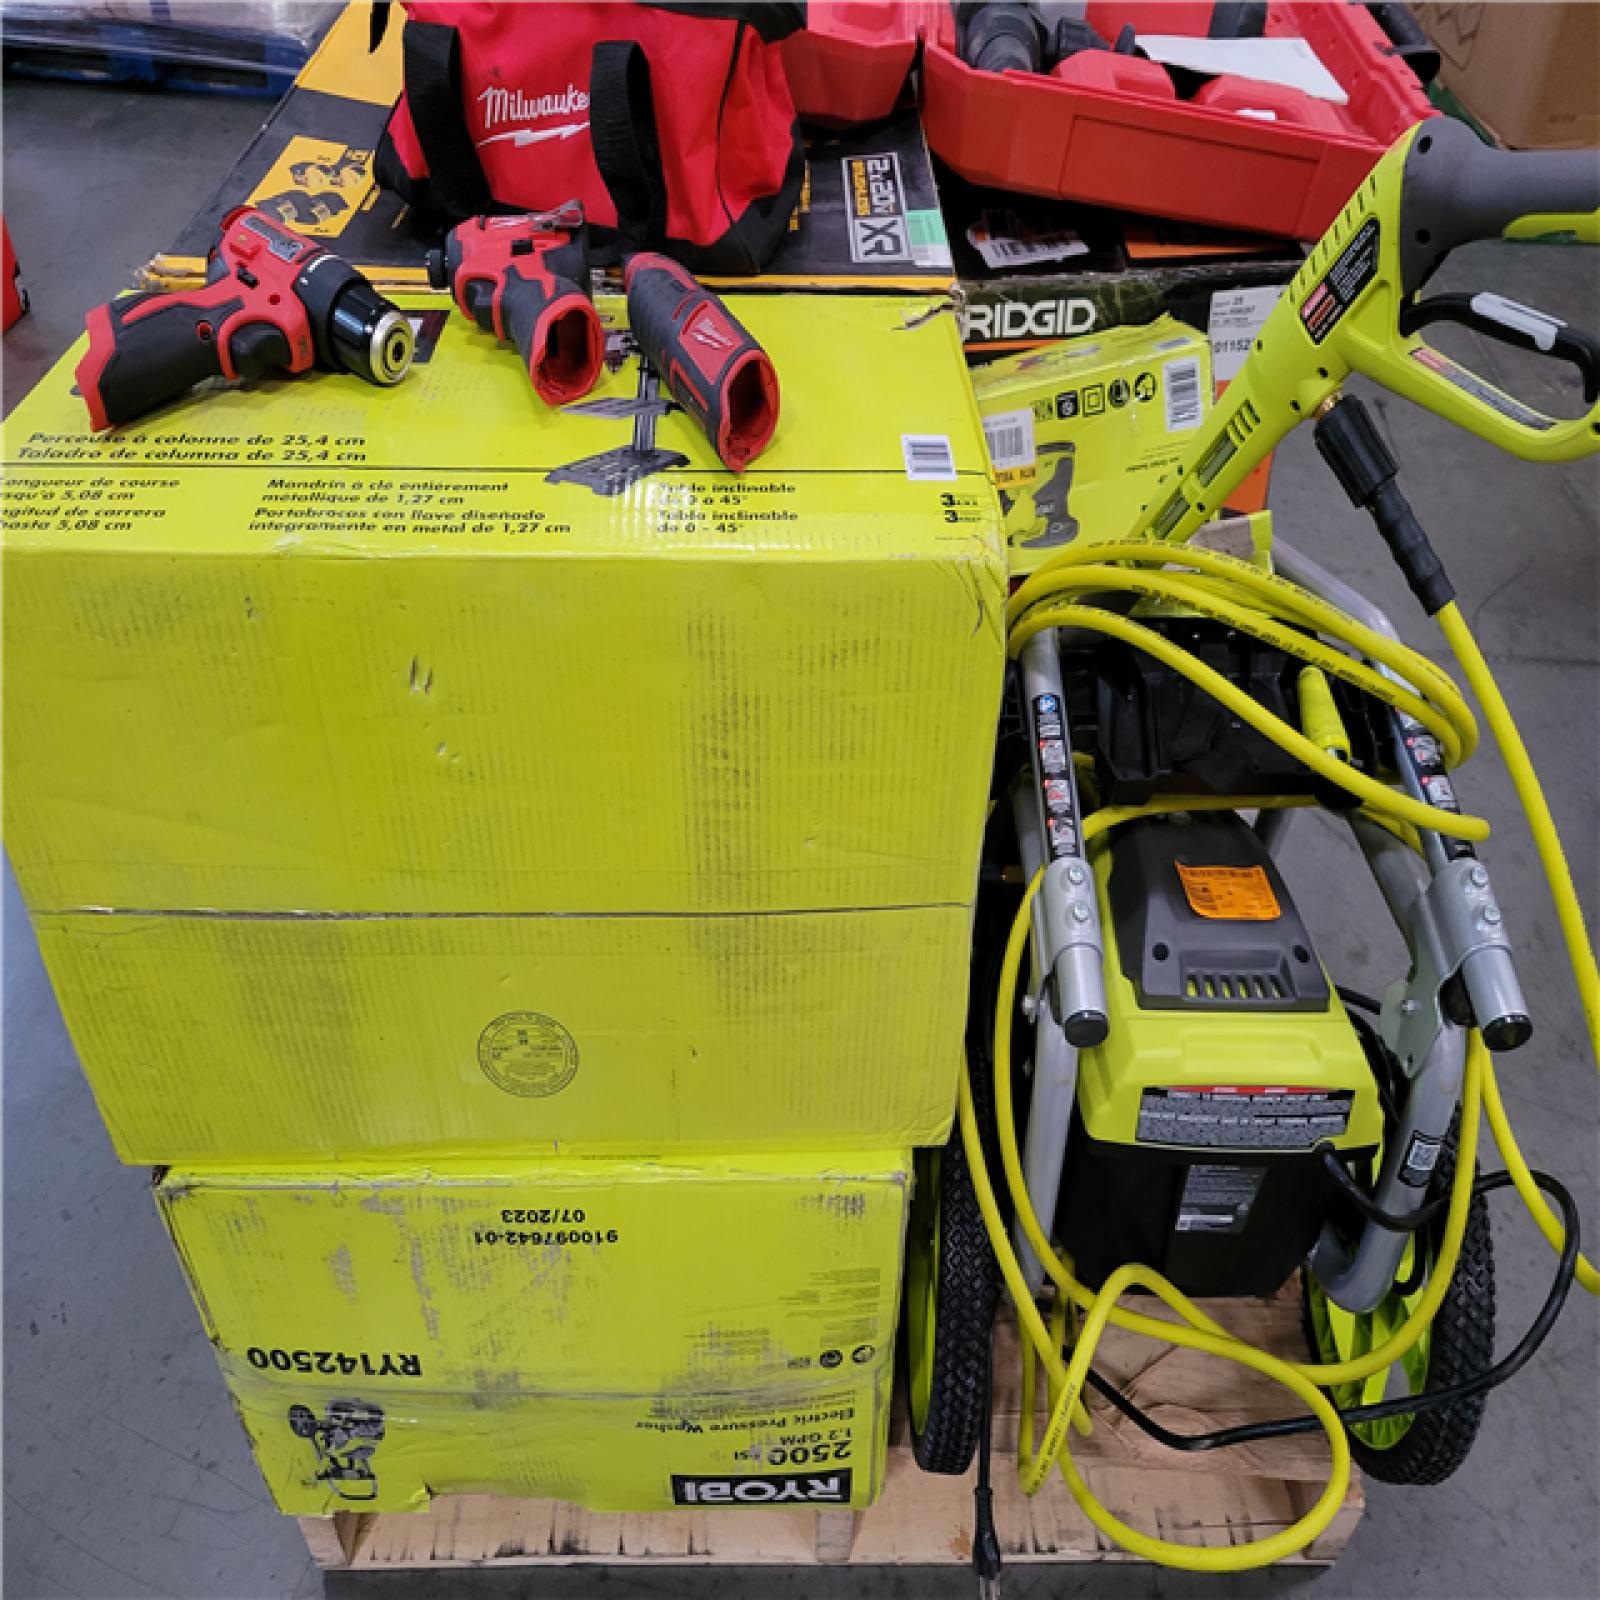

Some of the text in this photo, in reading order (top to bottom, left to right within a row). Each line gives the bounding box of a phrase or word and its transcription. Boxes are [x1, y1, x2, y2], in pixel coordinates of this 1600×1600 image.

[477, 83, 590, 128] Milwauke
[859, 220, 903, 258] XR
[964, 298, 1097, 339] RIDGID
[28, 432, 125, 444] Perceuse
[154, 432, 240, 445] colonne
[247, 434, 274, 446] de
[281, 434, 329, 448] 25,4
[335, 437, 366, 446] cm
[18, 447, 366, 463] Taladro de columna de 25,4 cm
[3, 477, 181, 488] ongueur de course
[267, 479, 345, 489] Mandrin
[712, 482, 796, 494] inclinable
[60, 489, 103, 501] 5,08
[107, 491, 135, 501] cm
[366, 492, 388, 503] de
[397, 494, 433, 505] 1,27
[439, 496, 464, 505] cm
[940, 493, 956, 506] 3
[65, 504, 88, 516] de
[95, 509, 166, 517] carrera
[255, 507, 366, 518] Portabrocas
[373, 510, 405, 519] con
[411, 510, 455, 520] llave
[657, 509, 798, 521] Tabla inclinable
[944, 509, 959, 523] 3
[56, 519, 101, 532] 5,08
[105, 522, 133, 531] cm
[382, 524, 406, 533] en
[412, 522, 466, 533] metal
[472, 522, 495, 533] de
[504, 522, 540, 535] 1,27
[545, 524, 571, 534] cm
[657, 522, 678, 533] de
[501, 1209, 586, 1224] 07/2023
[474, 1230, 618, 1245] 910097642-01
[247, 1347, 422, 1377] RY142500
[635, 1407, 856, 1434] Electric Pressure Washer
[780, 1427, 851, 1446] 1.2 GPM
[766, 1439, 853, 1466] 2500
[684, 1477, 844, 1502] RYOBI
